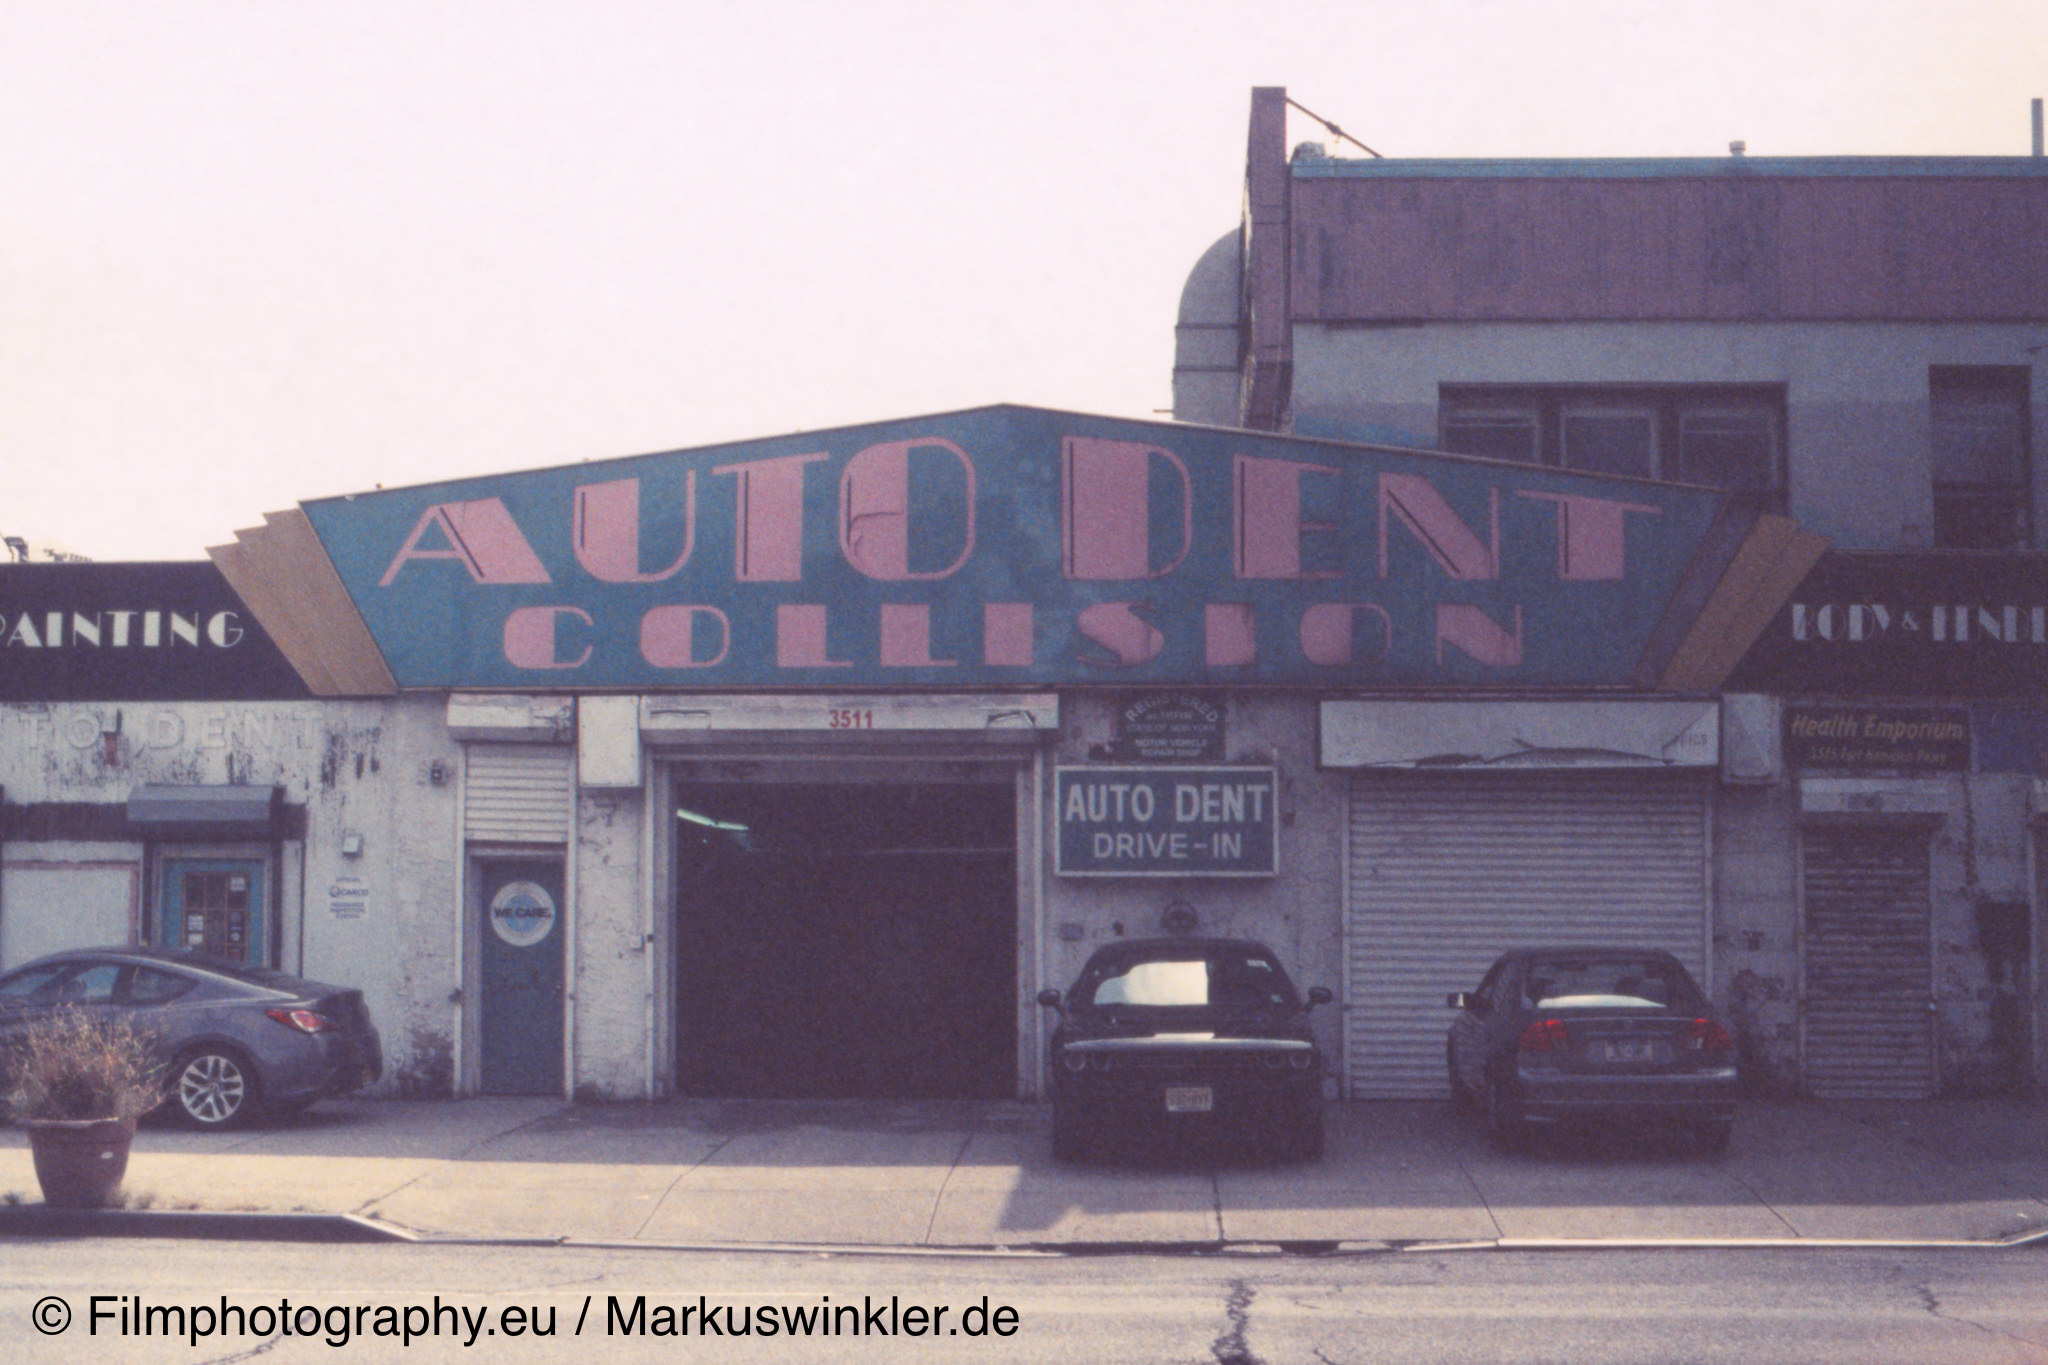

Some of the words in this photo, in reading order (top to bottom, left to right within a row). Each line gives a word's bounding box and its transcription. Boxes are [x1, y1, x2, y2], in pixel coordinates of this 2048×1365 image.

[378, 436, 976, 586] AUTO
[1062, 436, 1662, 580] DENT
[0, 610, 244, 648] AINTING
[504, 602, 1522, 669] COLLISION
[1902, 611, 1919, 631] &
[150, 711, 322, 750] DENT
[829, 709, 873, 729] 3511
[1791, 713, 1857, 738] Health
[1864, 714, 1963, 744] Emporium
[1065, 784, 1155, 823] AUTO
[1175, 784, 1270, 823] DENT
